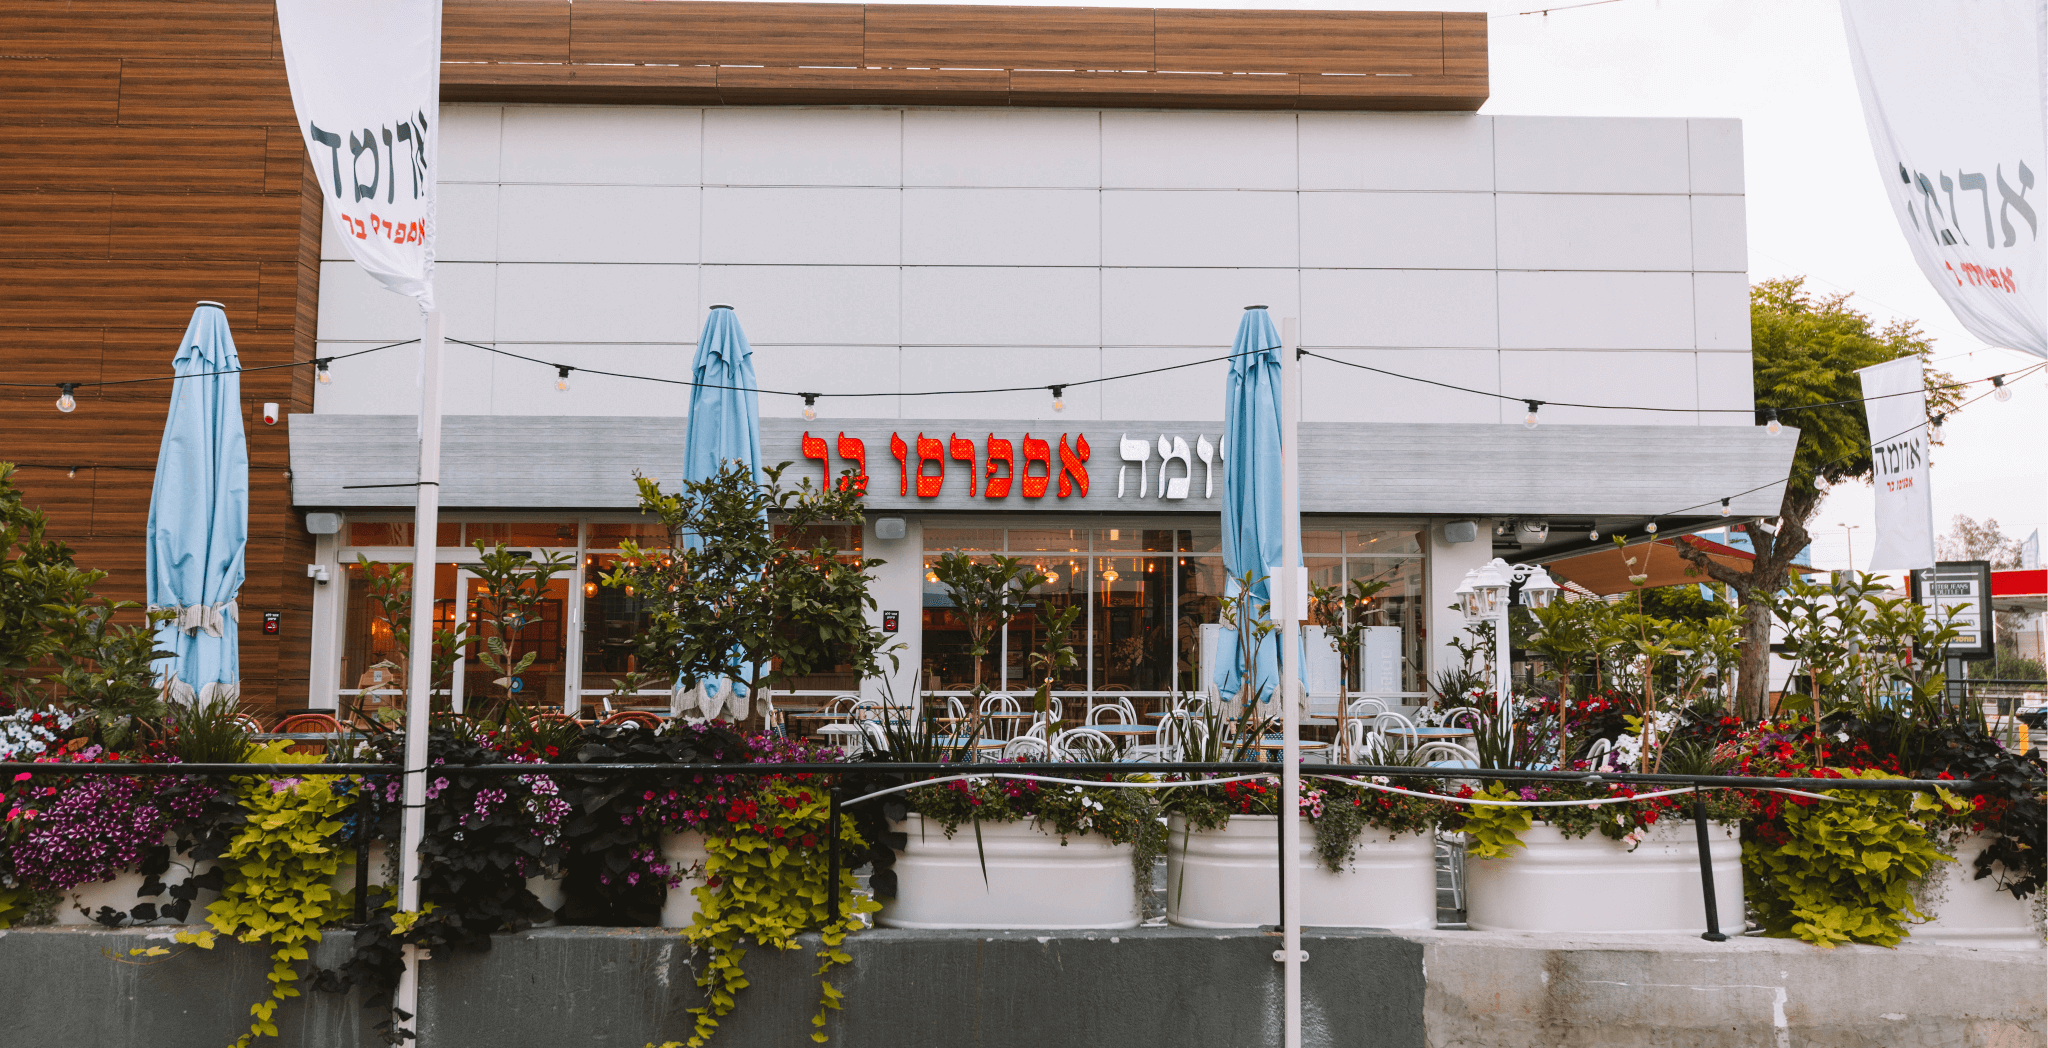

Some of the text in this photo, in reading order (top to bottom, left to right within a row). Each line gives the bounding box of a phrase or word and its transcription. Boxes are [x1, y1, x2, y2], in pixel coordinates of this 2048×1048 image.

[341, 212, 368, 241] בר
[801, 430, 1225, 500] ומה אספרסו בר
[1874, 437, 1921, 477] ארומה
